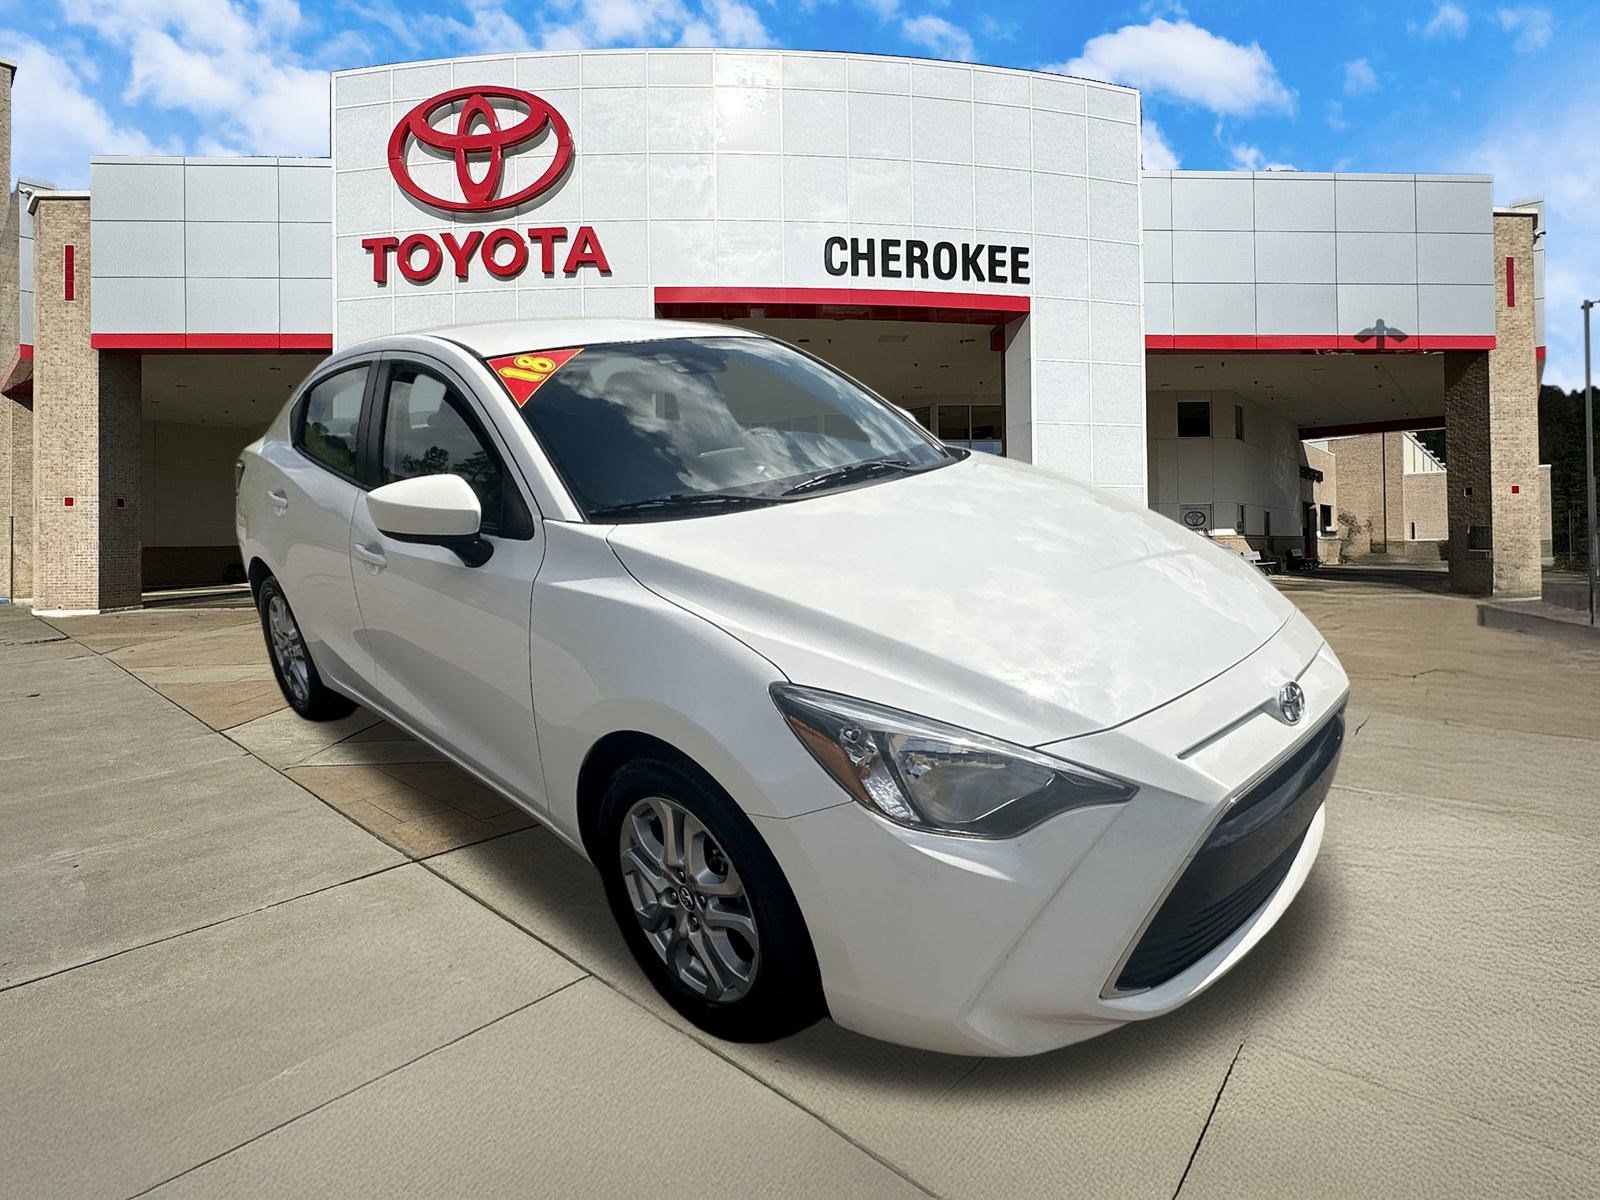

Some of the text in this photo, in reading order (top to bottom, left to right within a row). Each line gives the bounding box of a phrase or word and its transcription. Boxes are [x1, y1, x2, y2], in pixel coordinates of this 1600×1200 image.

[362, 226, 612, 284] TOYOTA
[824, 236, 1031, 285] CHEROKEE
[498, 355, 556, 382] 18
